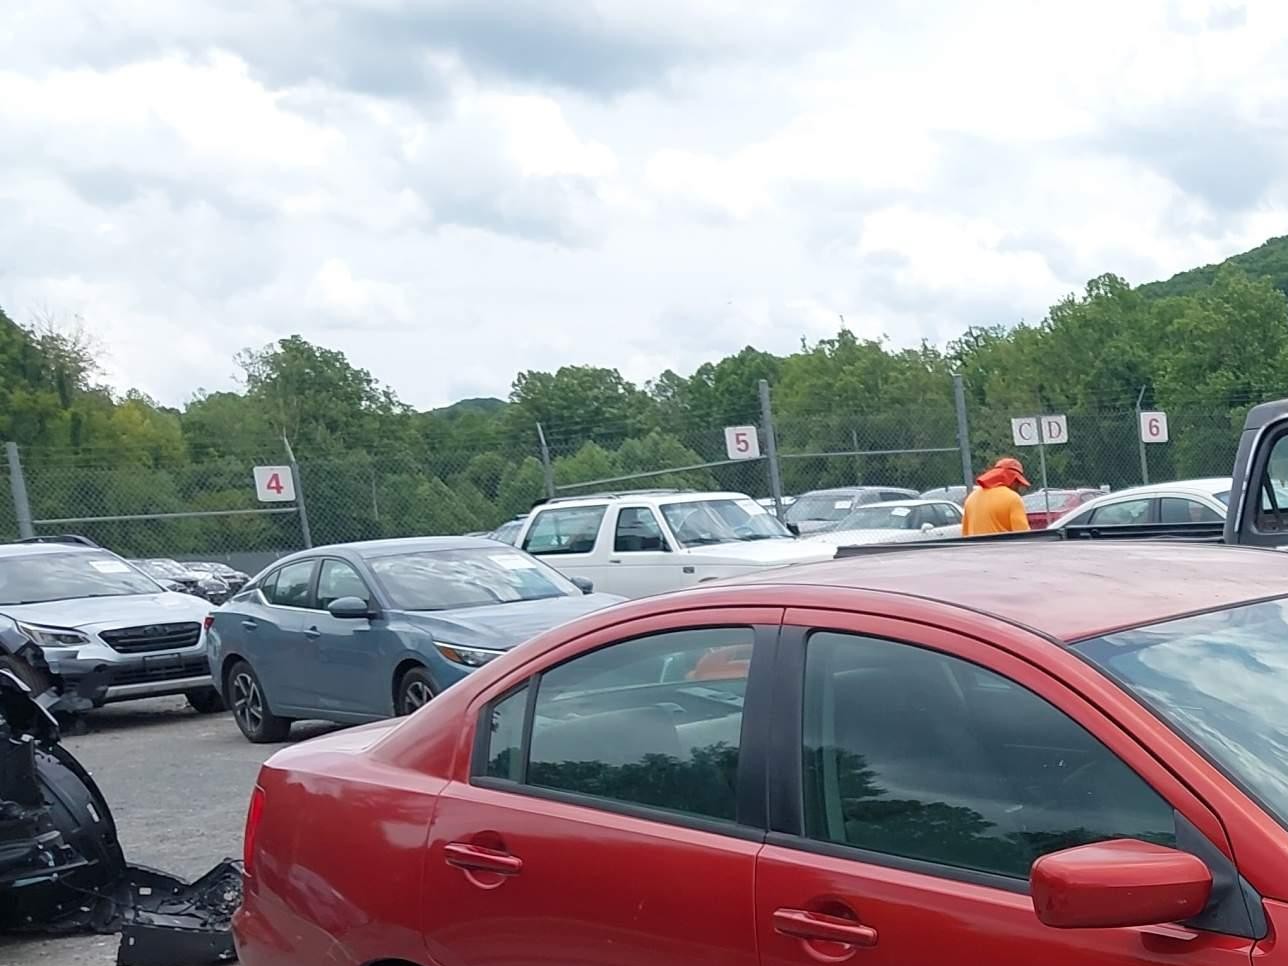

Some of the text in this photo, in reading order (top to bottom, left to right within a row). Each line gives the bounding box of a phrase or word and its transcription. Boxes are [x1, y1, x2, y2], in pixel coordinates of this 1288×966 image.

[1019, 422, 1032, 440] C
[1048, 421, 1062, 438] D
[1149, 418, 1160, 437] 6
[735, 432, 750, 452] 5
[266, 473, 284, 495] 4
